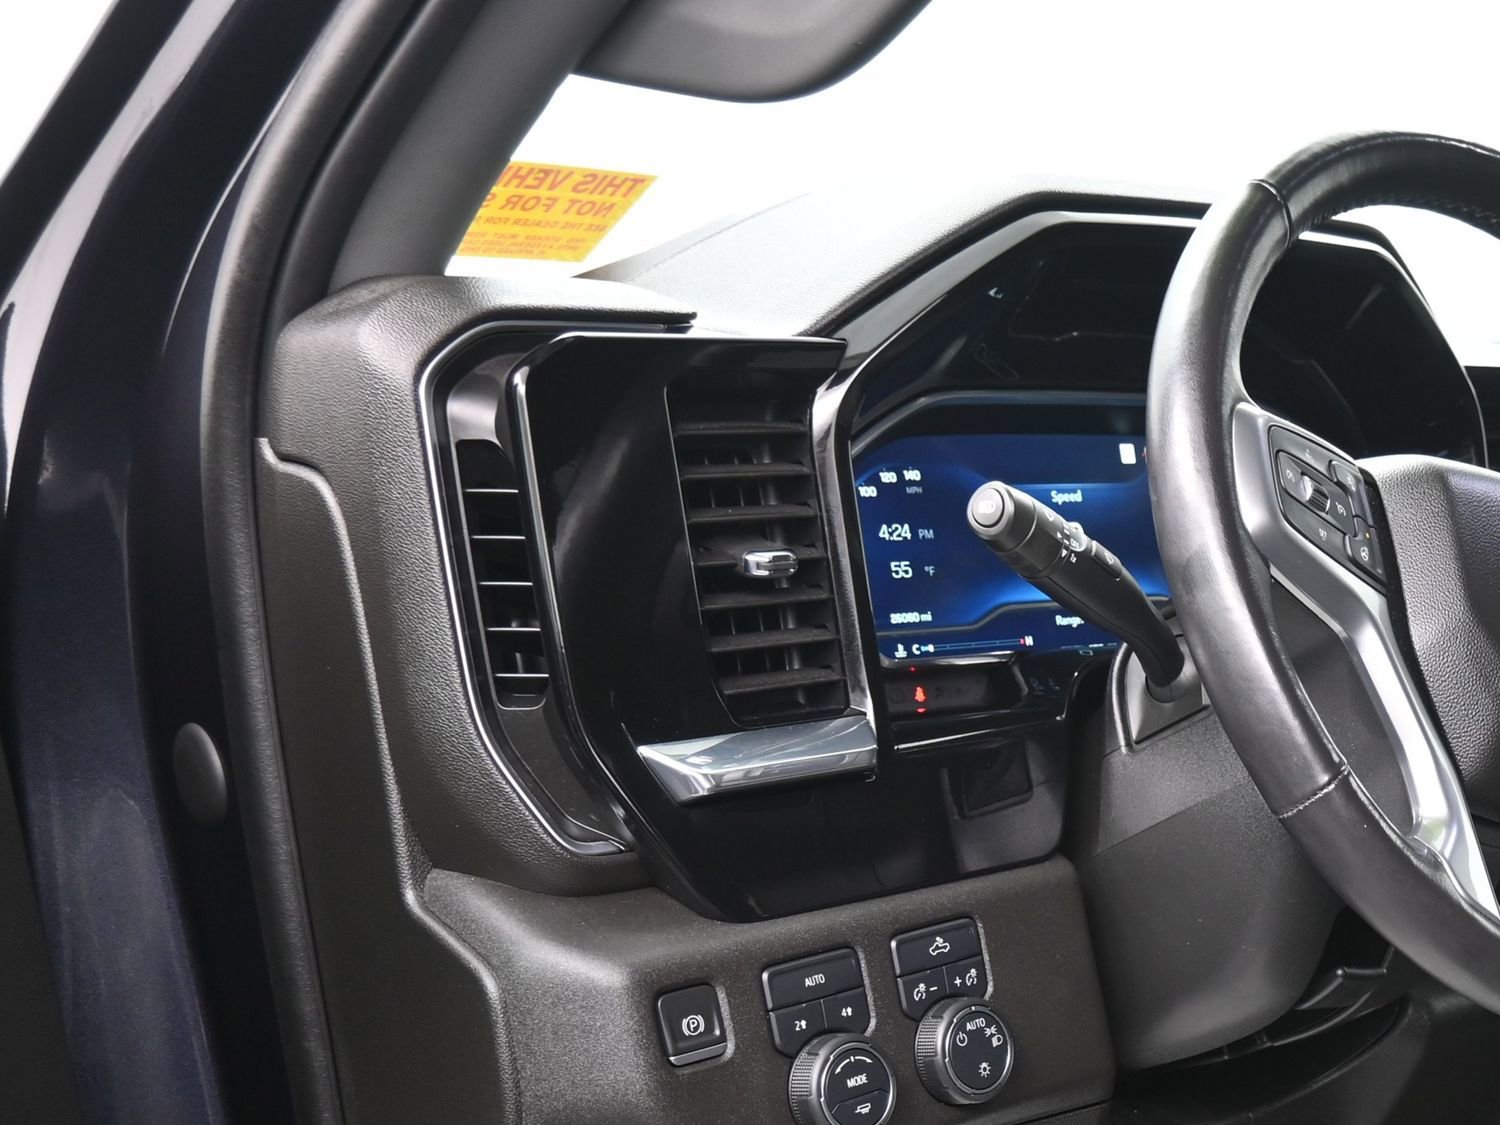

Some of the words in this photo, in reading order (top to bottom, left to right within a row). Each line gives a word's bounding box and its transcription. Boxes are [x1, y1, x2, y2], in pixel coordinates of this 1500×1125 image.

[879, 471, 898, 483] 120
[902, 469, 922, 481] 140
[858, 486, 878, 497] 100
[906, 486, 923, 494] MPH
[1050, 489, 1083, 504] Speed
[878, 523, 912, 541] 4:24
[918, 528, 934, 540] PM
[890, 561, 913, 579] 55
[920, 611, 932, 622] mi
[804, 974, 826, 988] AUTO
[965, 1017, 986, 1032] AUTO
[846, 1073, 868, 1089] MODE
